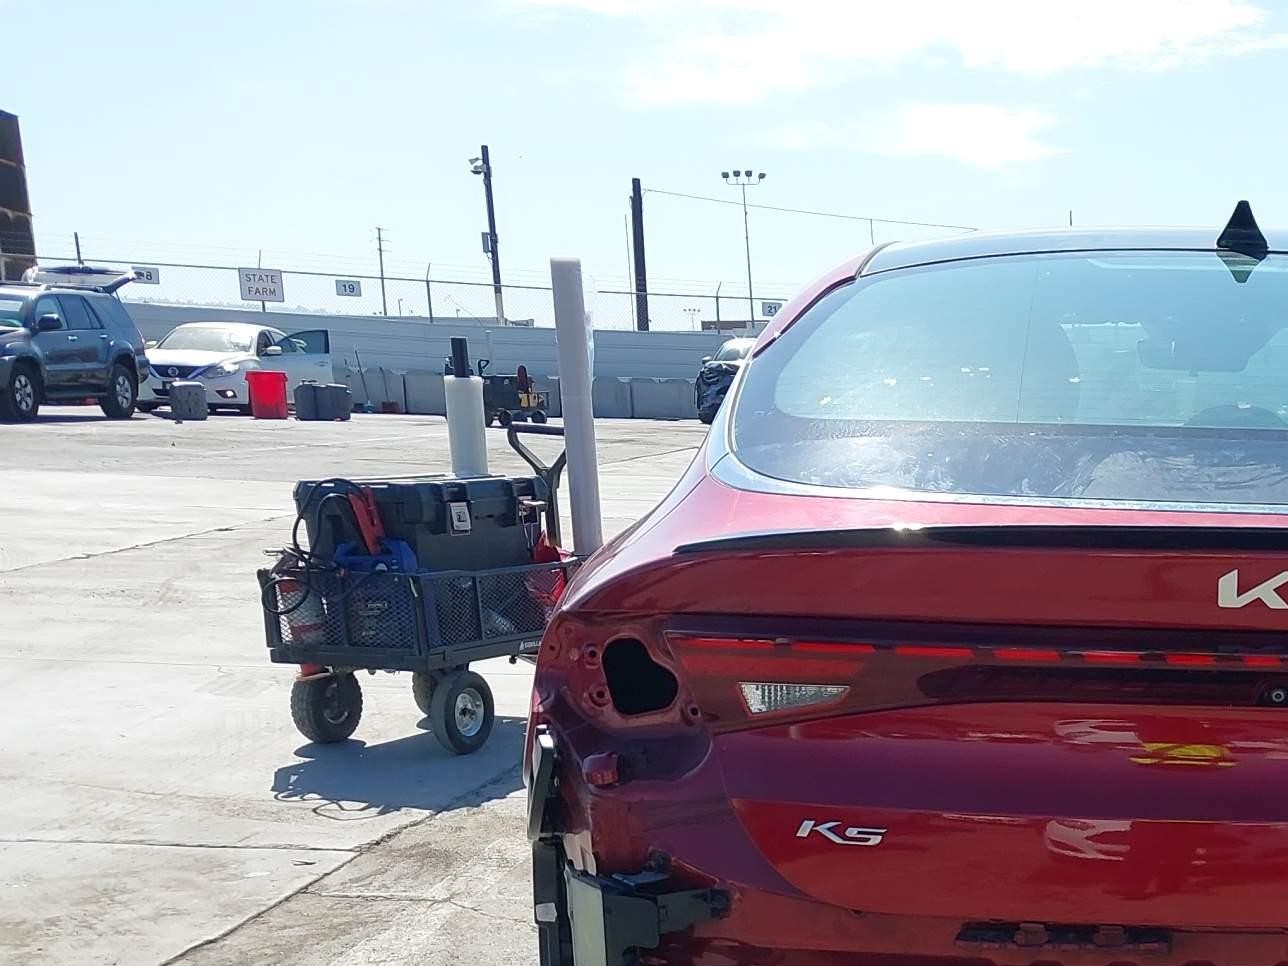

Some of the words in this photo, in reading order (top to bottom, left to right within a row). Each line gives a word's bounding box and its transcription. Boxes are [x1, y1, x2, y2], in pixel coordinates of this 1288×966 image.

[244, 273, 277, 284] STATE
[247, 286, 277, 297] FARM
[342, 283, 355, 293] 19
[767, 305, 777, 313] 21
[796, 820, 888, 846] K5
